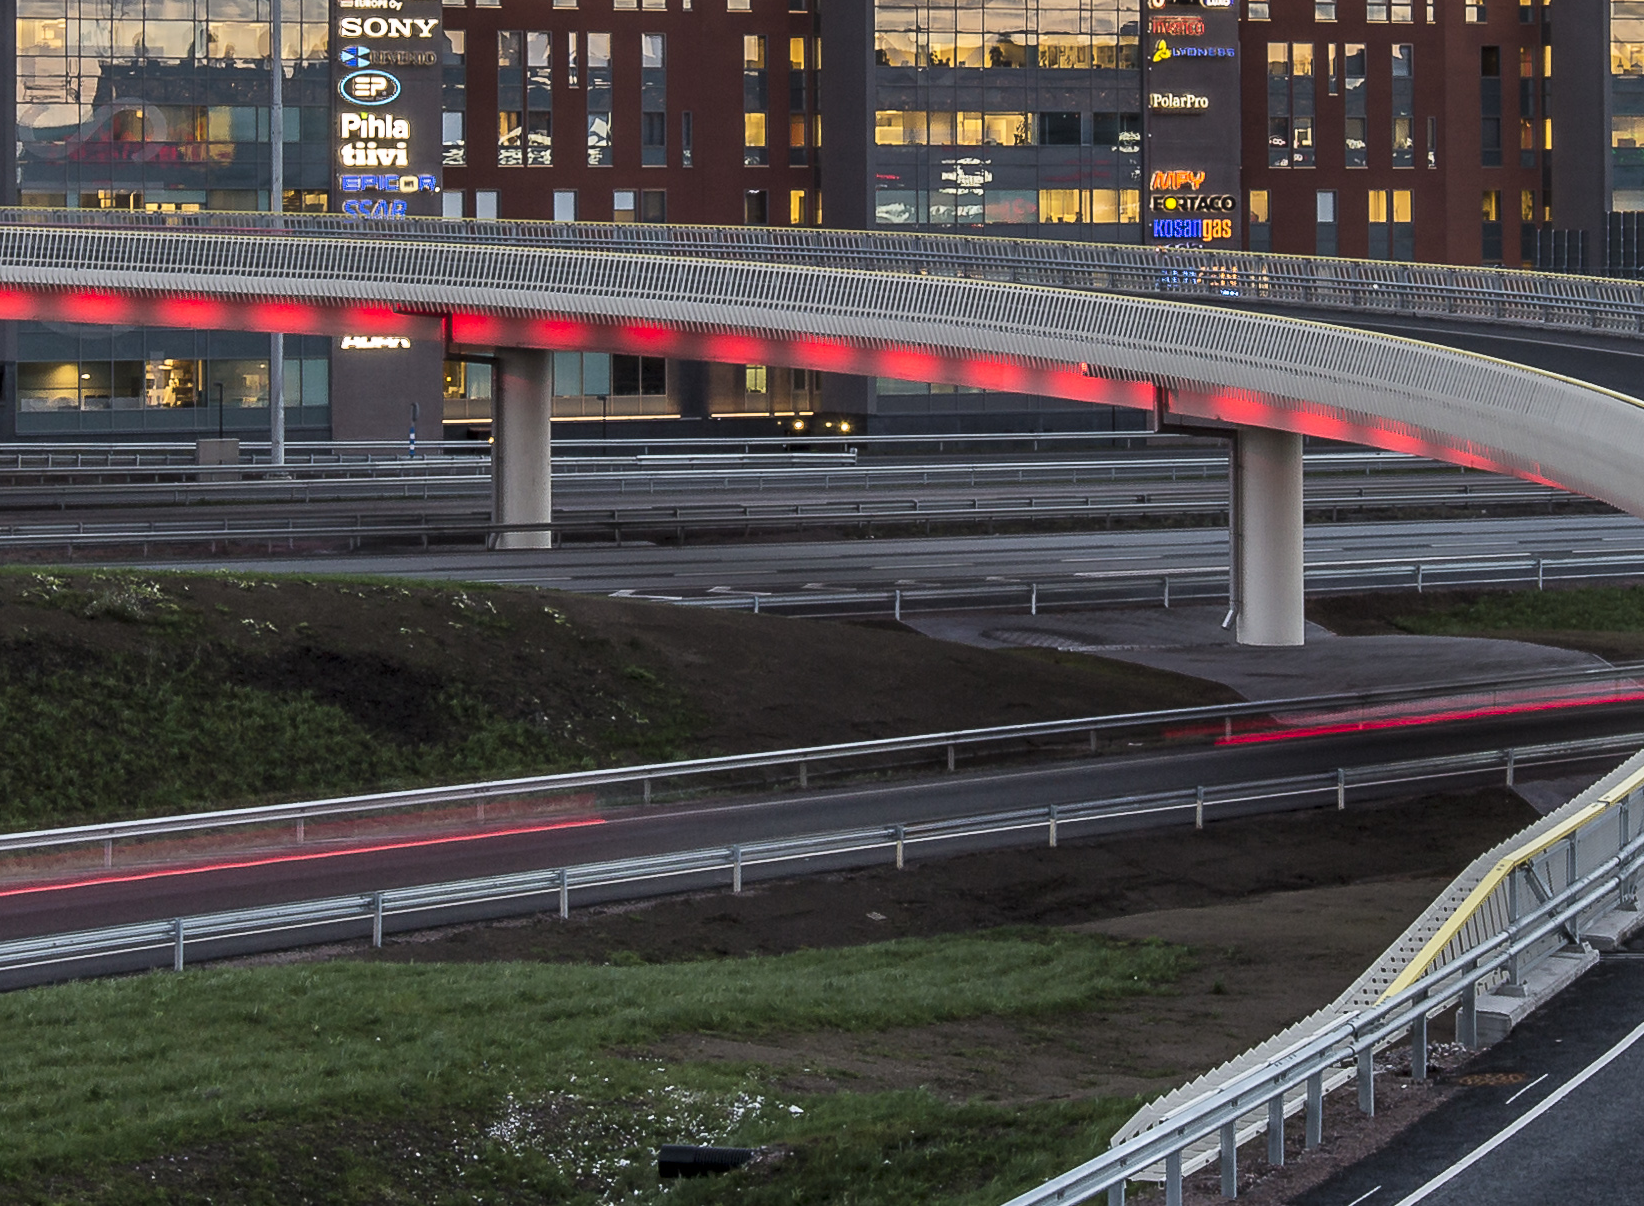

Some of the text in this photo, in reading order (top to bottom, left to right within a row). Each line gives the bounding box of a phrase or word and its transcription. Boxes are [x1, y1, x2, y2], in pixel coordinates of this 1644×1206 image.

[354, 0, 403, 11] EUROPE Oy
[339, 17, 439, 39] SONY
[353, 76, 387, 97] EP
[1152, 93, 1209, 108] PolarPro
[340, 112, 410, 139] Pihla
[340, 141, 409, 167] tiivi
[1151, 171, 1205, 190] MPY
[1151, 195, 1236, 212] FORTACO
